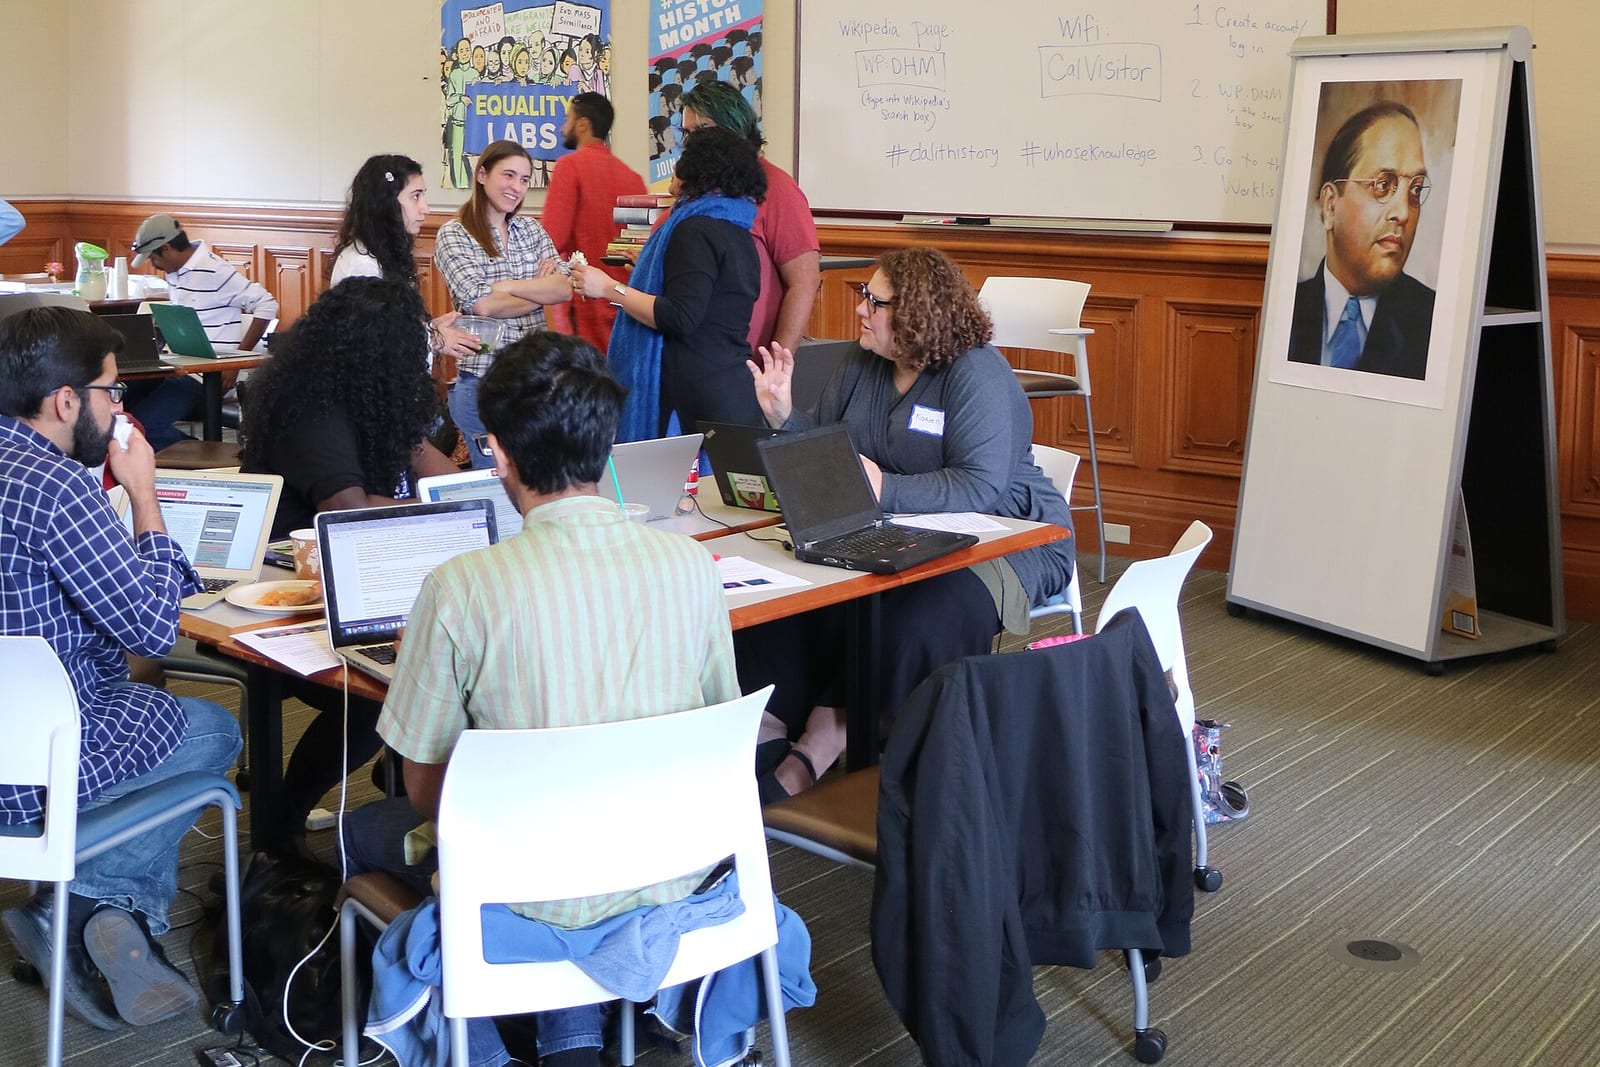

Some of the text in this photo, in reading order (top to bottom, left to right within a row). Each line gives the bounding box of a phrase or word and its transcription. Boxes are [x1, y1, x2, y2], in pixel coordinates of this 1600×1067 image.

[476, 16, 490, 26] AND
[659, 0, 736, 30] HISTO
[1215, 7, 1258, 28] Create
[659, 4, 742, 50] MONTH
[839, 18, 900, 44] Wikipedia
[1229, 35, 1264, 57] log in
[476, 95, 575, 116] EQUALITY
[886, 143, 1000, 168] #dalithistory
[1214, 146, 1233, 166] Go
[1241, 152, 1258, 168] to
